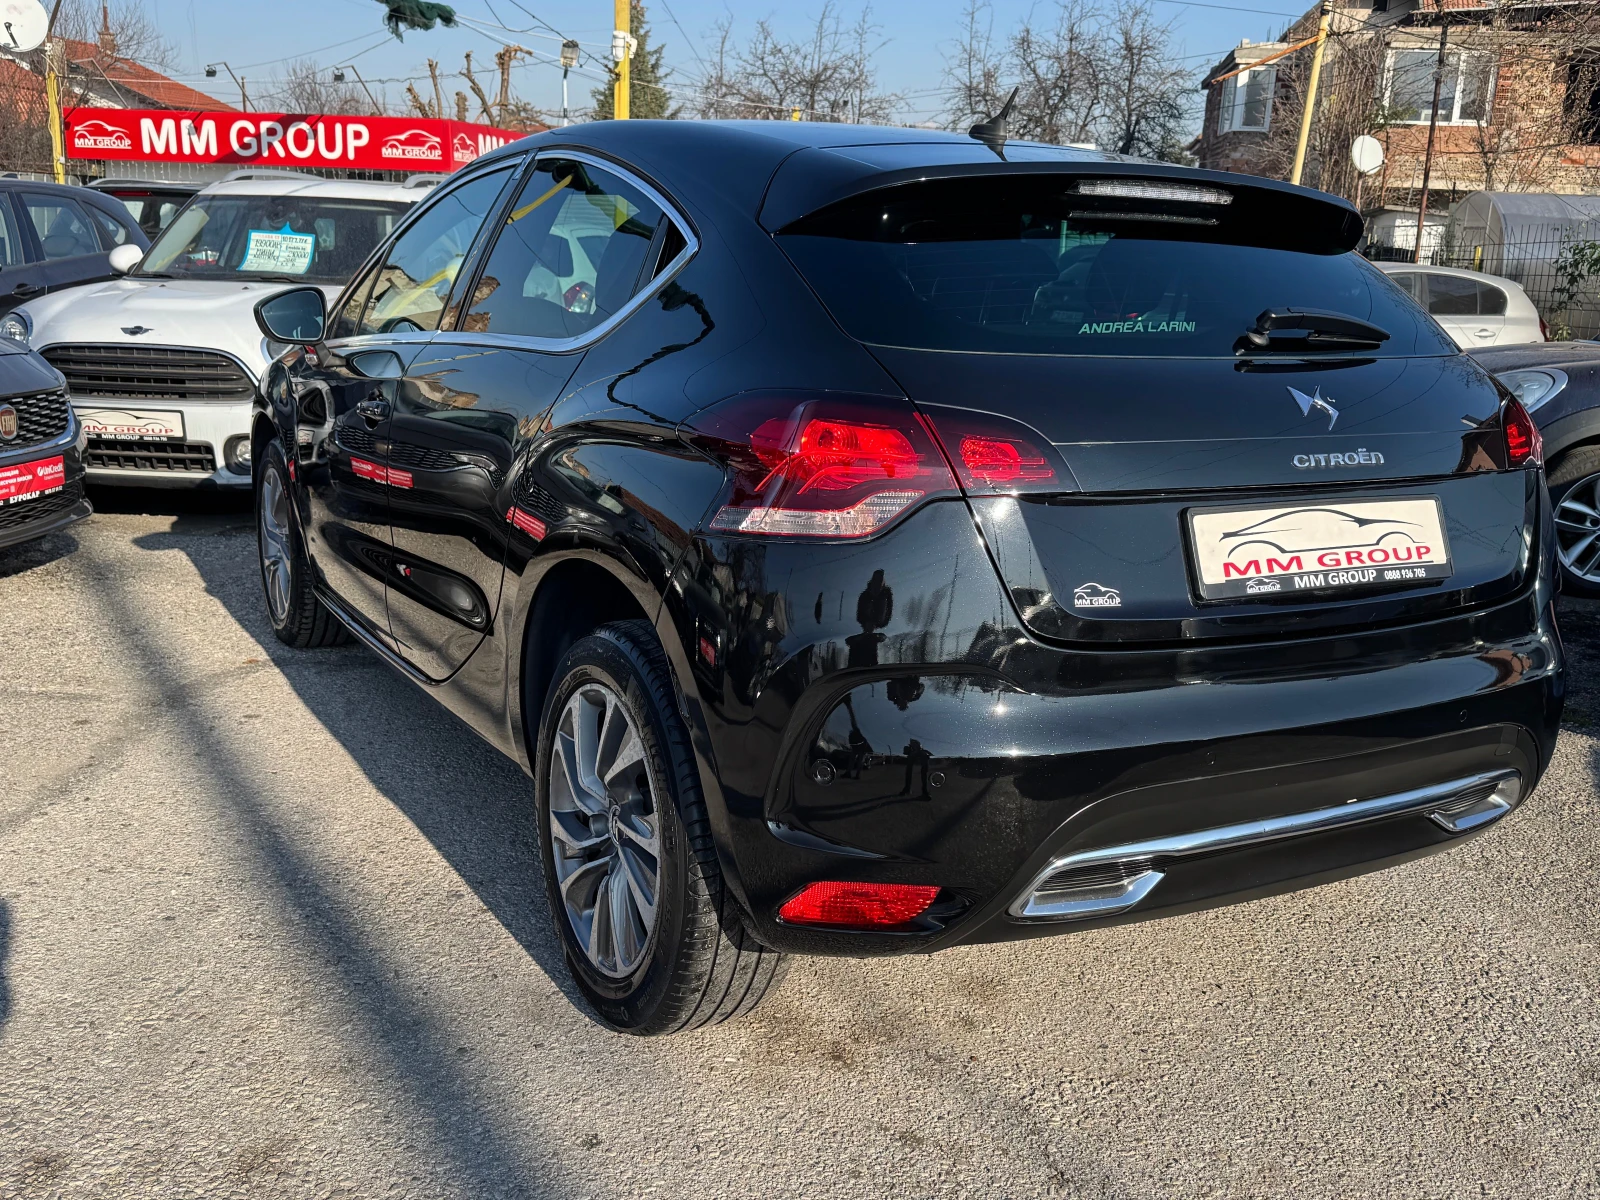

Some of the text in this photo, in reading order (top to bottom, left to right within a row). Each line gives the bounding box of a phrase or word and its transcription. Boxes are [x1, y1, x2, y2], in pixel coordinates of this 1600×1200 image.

[74, 138, 132, 148] MM GROUP
[140, 118, 370, 160] MM GROUP
[382, 147, 442, 158] MM GROUP
[1078, 321, 1196, 335] ANDREA LARINI
[114, 426, 174, 435] GROUP
[1291, 447, 1385, 468] CITROËN
[1222, 546, 1431, 578] MM GROUP
[1294, 567, 1426, 589] MM GROUP 0888 936 705
[1074, 597, 1121, 606] MM GROUP
